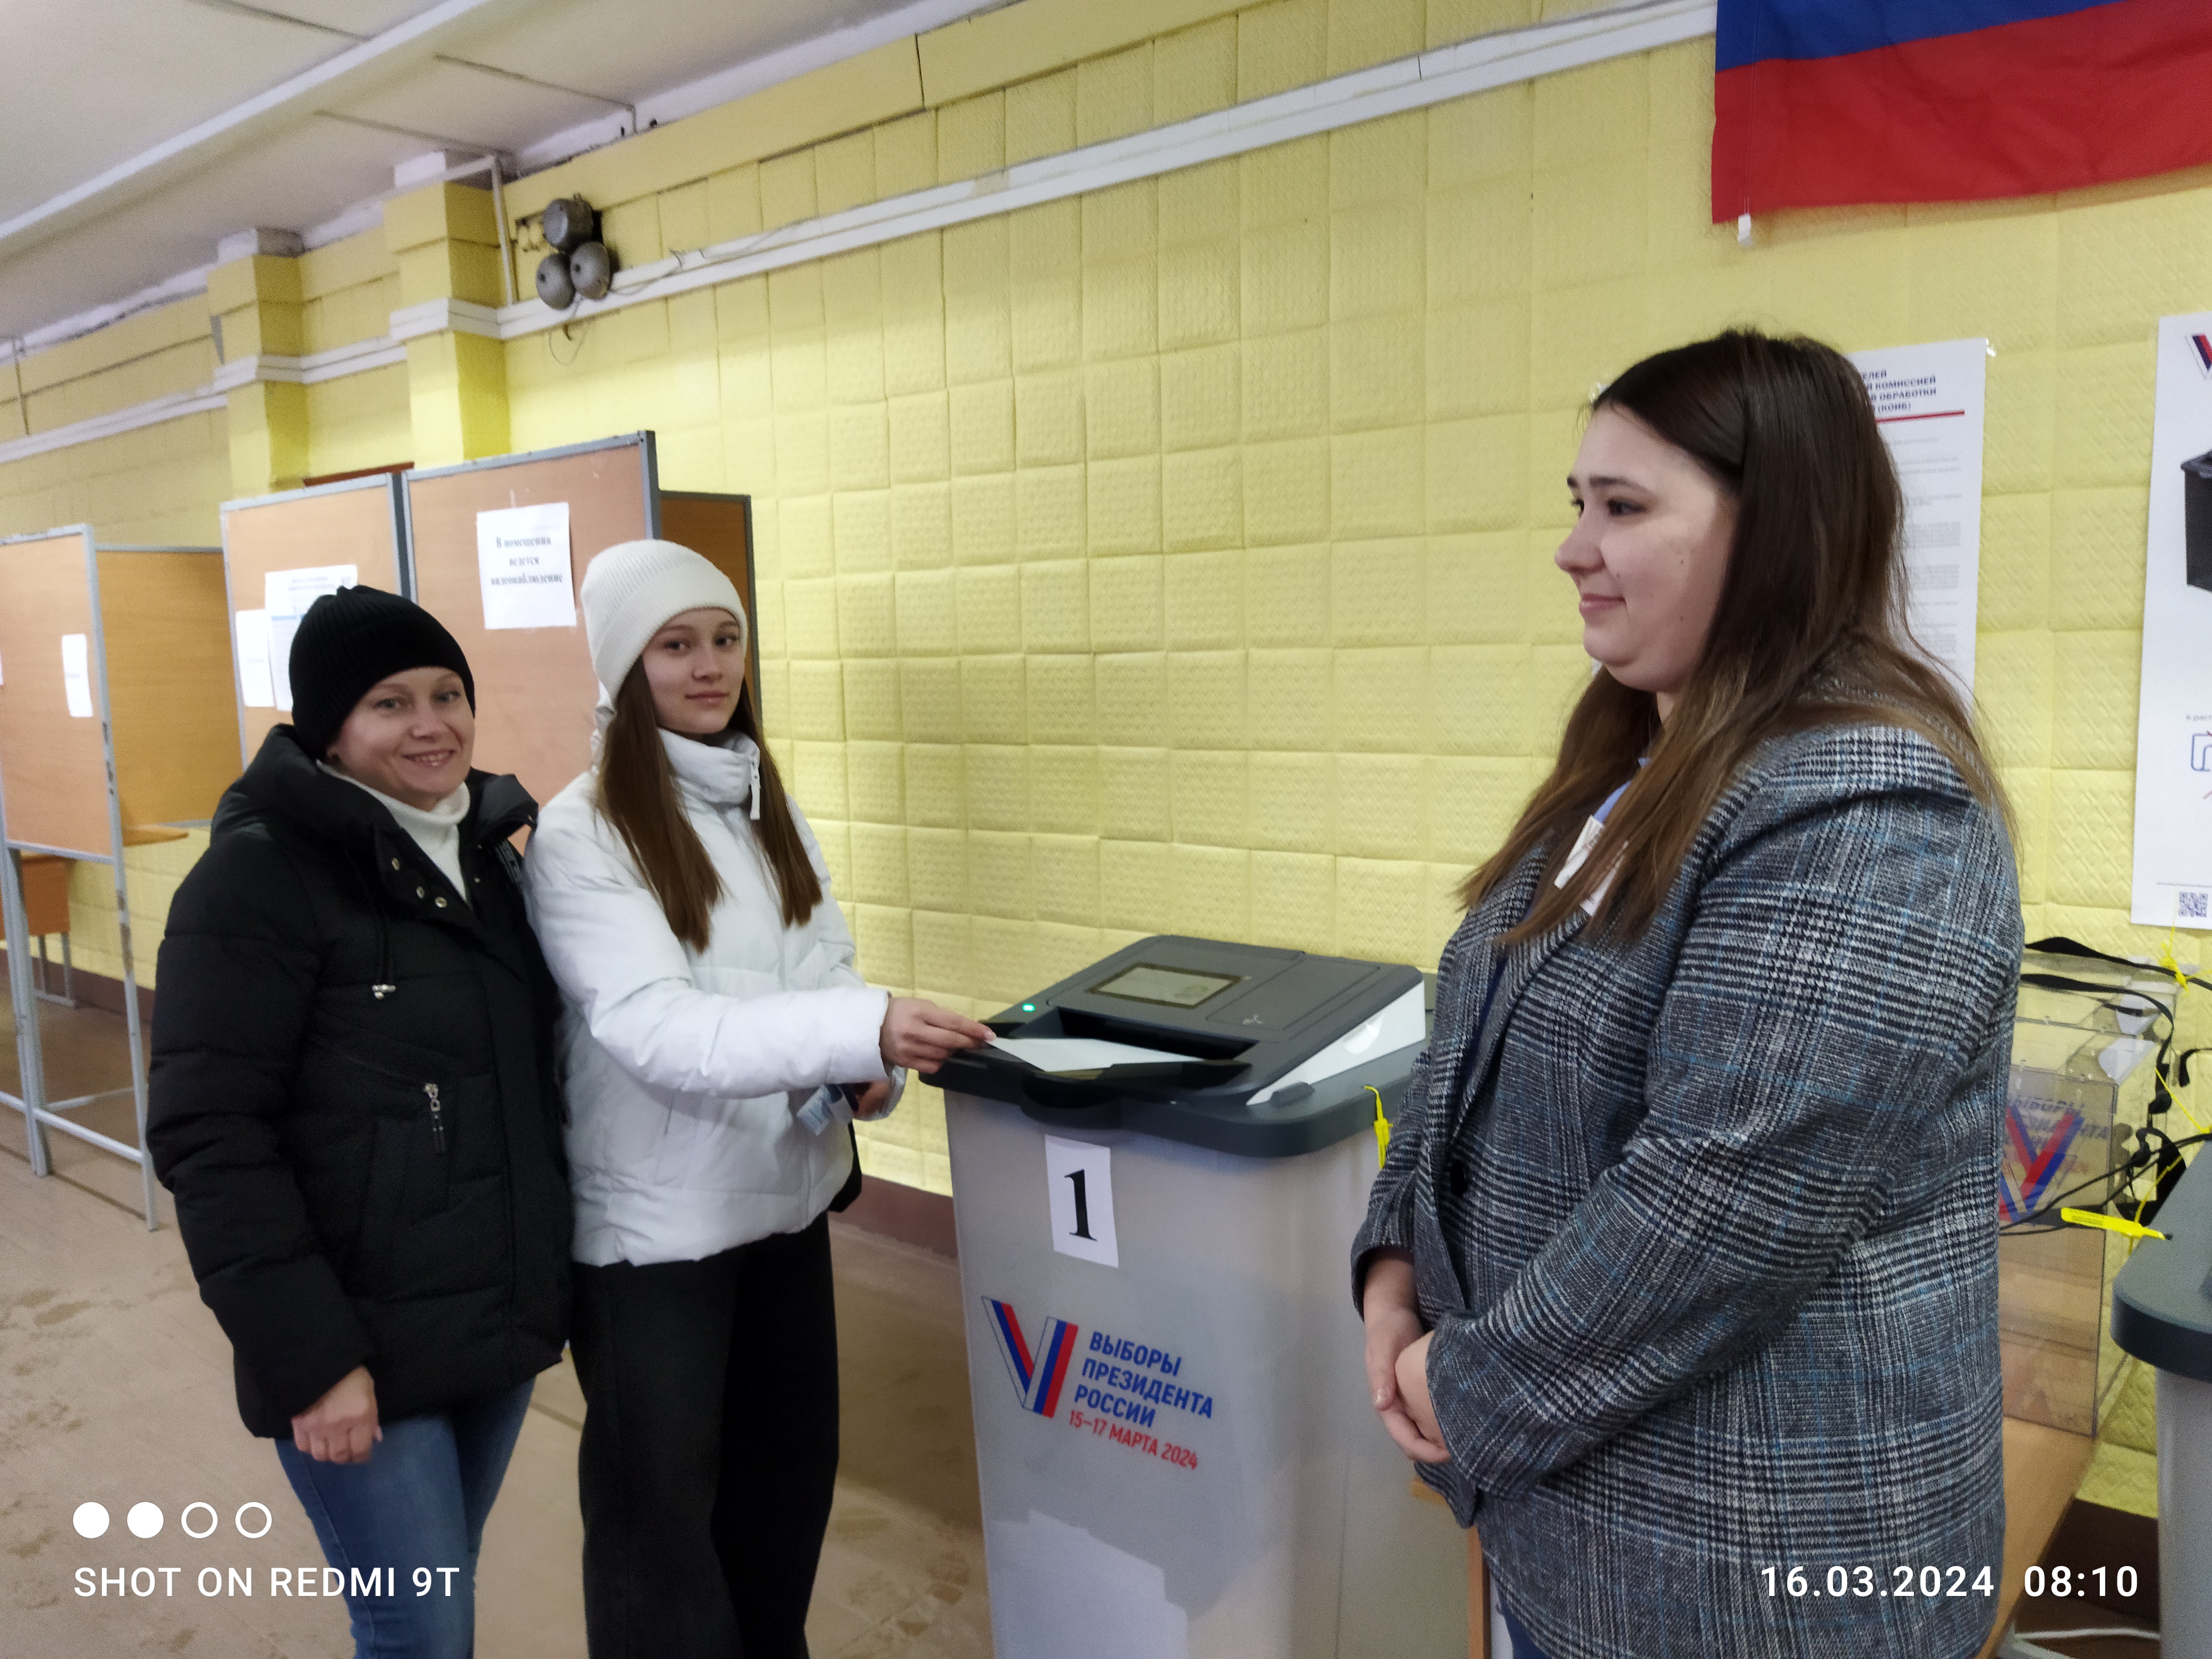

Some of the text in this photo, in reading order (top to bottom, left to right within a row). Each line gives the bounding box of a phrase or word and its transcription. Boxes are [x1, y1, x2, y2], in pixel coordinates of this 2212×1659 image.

[1862, 369, 1887, 379] ЕЛЕЙ
[495, 536, 552, 548] В помещении
[509, 556, 540, 566] ведется
[491, 572, 564, 586] видеонаблюдение
[1065, 1169, 1097, 1241] 1
[1089, 1331, 1182, 1377] ВЫБОРЫ
[1074, 1384, 1156, 1428] РОССИИ
[1082, 1358, 1213, 1419] ПРЕЗИДЕНТА
[1109, 1423, 1159, 1457] МАРТА
[1161, 1442, 1198, 1470] 2024
